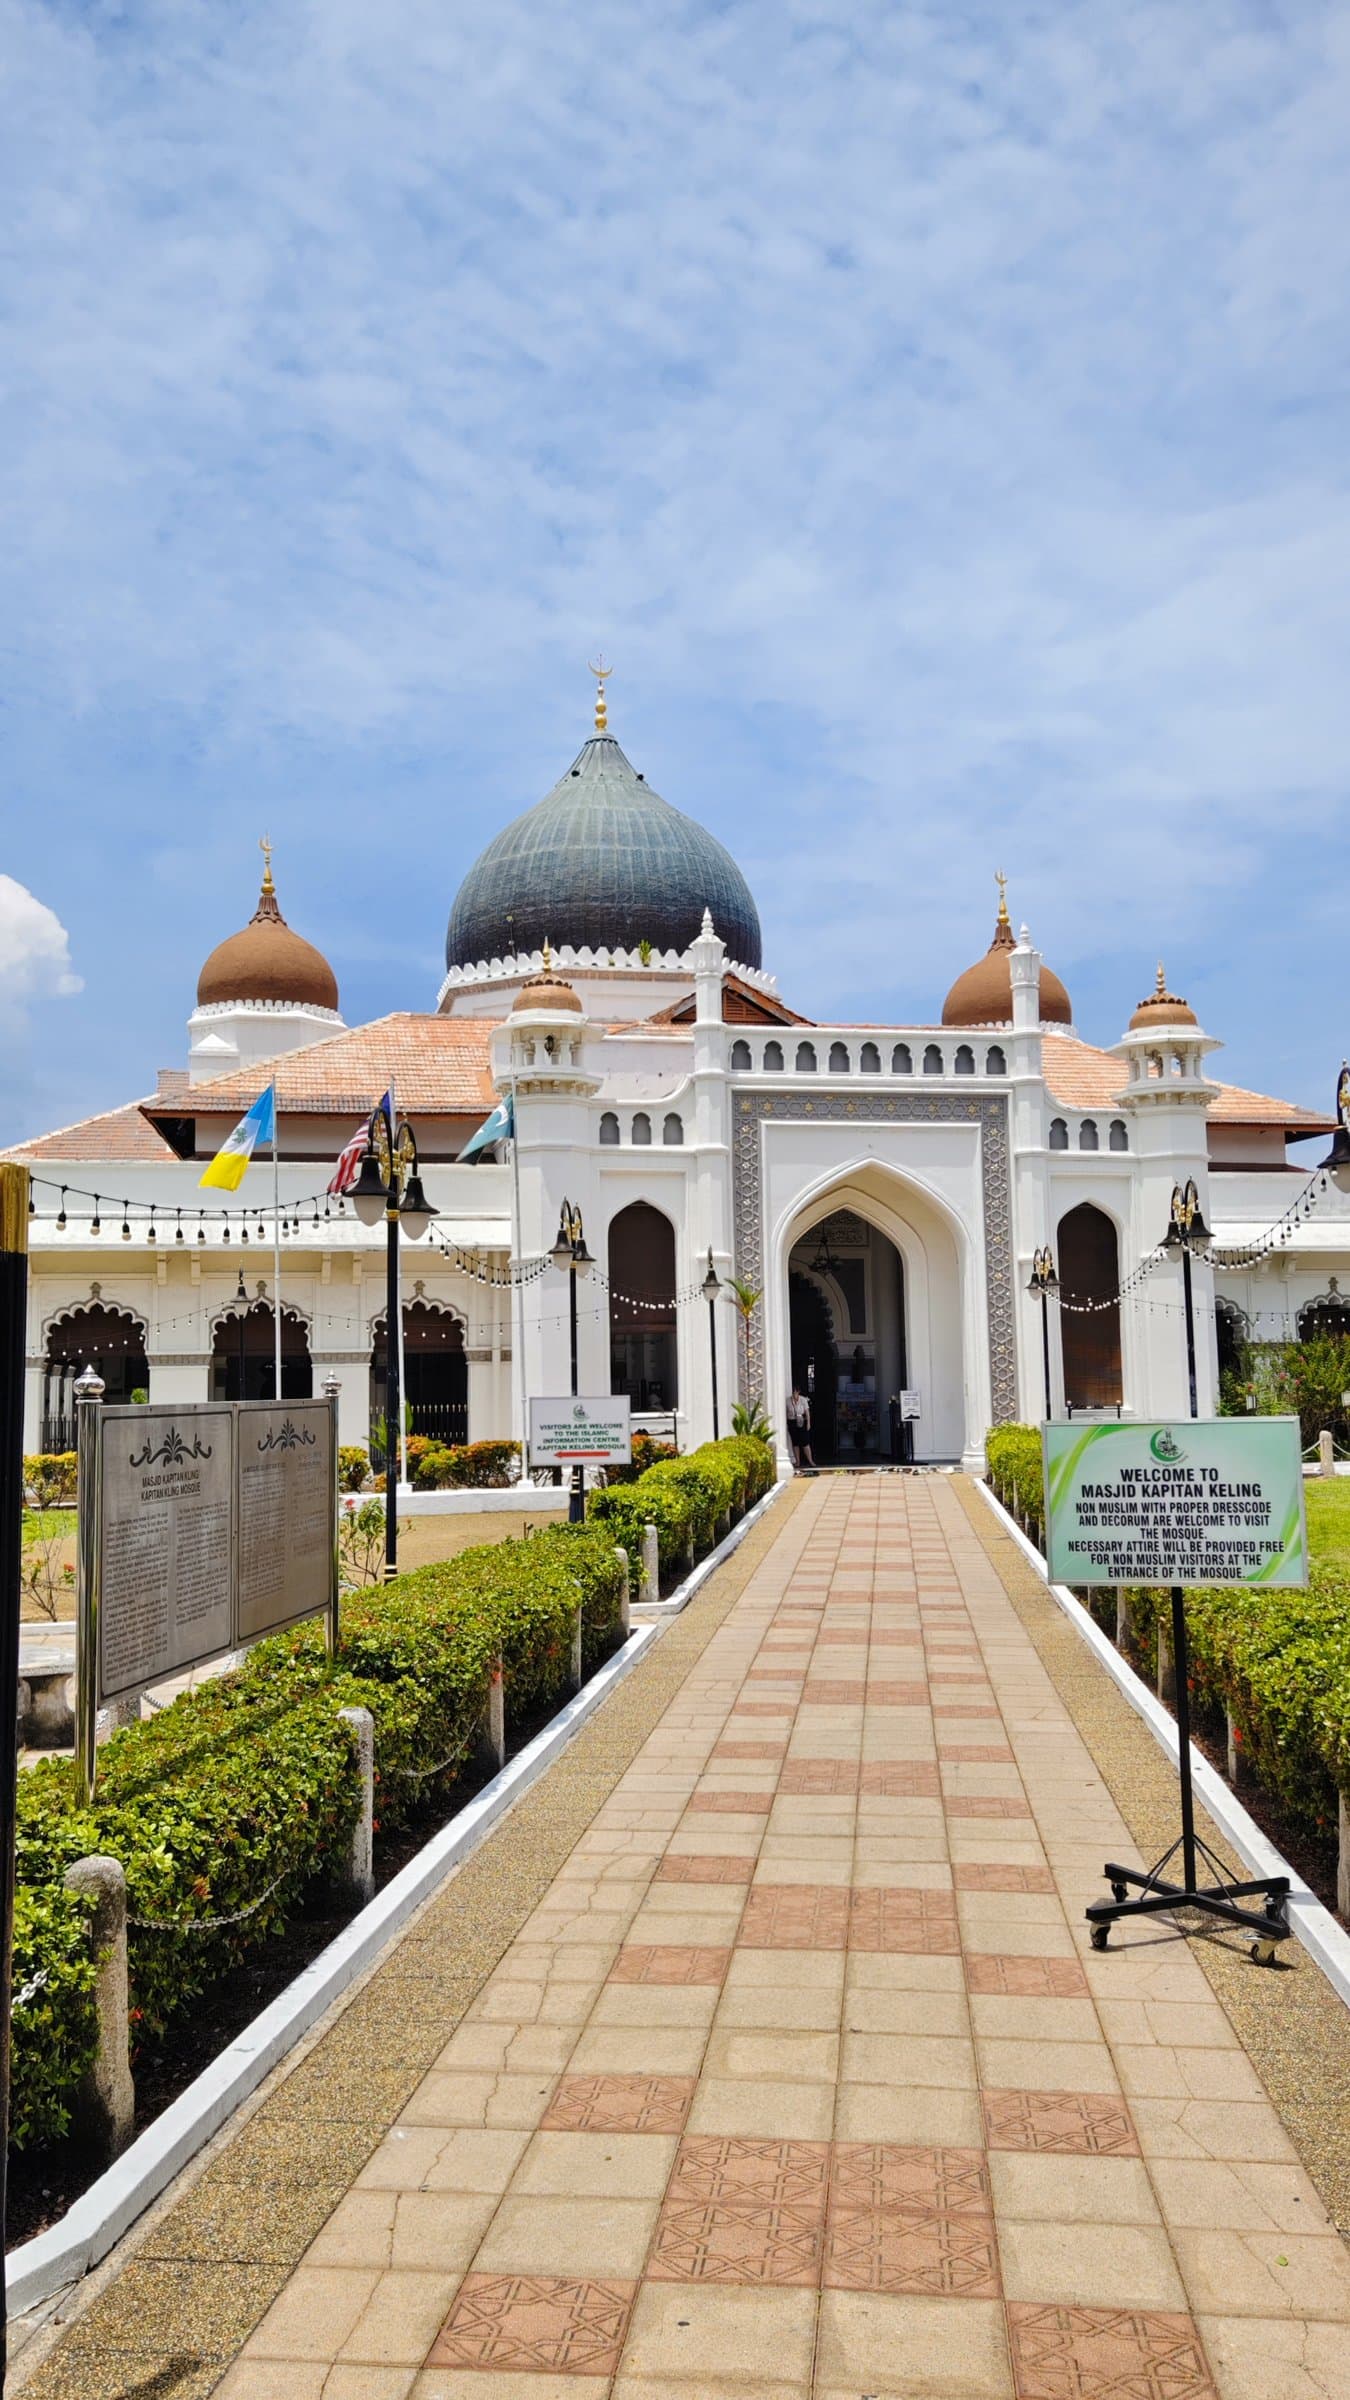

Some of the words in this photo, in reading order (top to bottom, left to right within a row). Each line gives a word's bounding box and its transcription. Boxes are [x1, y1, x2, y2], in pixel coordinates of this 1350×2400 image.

[142, 1474, 161, 1488] MASJID
[163, 1472, 184, 1484] KAPITAN
[1120, 1468, 1195, 1483] WELCOME
[1200, 1468, 1218, 1482] TO
[141, 1488, 163, 1501] KAPITAN
[164, 1485, 179, 1497] KLING
[181, 1481, 200, 1494] MOSQUE
[1082, 1484, 1136, 1498] MASJID
[1142, 1484, 1203, 1498] KAPITAN
[1209, 1483, 1261, 1497] KELING
[1076, 1502, 1095, 1514] NON
[1099, 1502, 1137, 1514] MUSLIM
[1141, 1502, 1166, 1513] WITH
[1170, 1502, 1209, 1513] PROPER
[1213, 1501, 1272, 1513] DRESSCODE
[1079, 1515, 1098, 1527] AND
[1102, 1515, 1150, 1527] DECORUM
[1153, 1515, 1172, 1526] ARE
[1175, 1515, 1225, 1526] WELCOME
[1228, 1515, 1241, 1526] TO
[1245, 1514, 1269, 1526] VISIT
[1141, 1528, 1159, 1540] THE
[1163, 1528, 1207, 1540] MOSQUE.
[1068, 1541, 1123, 1553] NECESSARY
[1127, 1541, 1160, 1552] ATTIRE
[1163, 1541, 1187, 1552] WILL
[1190, 1541, 1203, 1552] BE
[1206, 1541, 1256, 1552] PROVIDED
[1260, 1541, 1284, 1552] FREE
[1091, 1554, 1110, 1565] FOR
[1113, 1554, 1133, 1565] NON
[1137, 1554, 1175, 1565] MUSLIM
[1178, 1554, 1225, 1565] VISITORS
[1228, 1554, 1241, 1565] AT
[1244, 1554, 1262, 1565] THE
[1108, 1567, 1159, 1578] ENTRANCE
[1162, 1567, 1175, 1578] OF
[1178, 1567, 1196, 1578] THE
[1200, 1567, 1245, 1579] MOSQUE.
